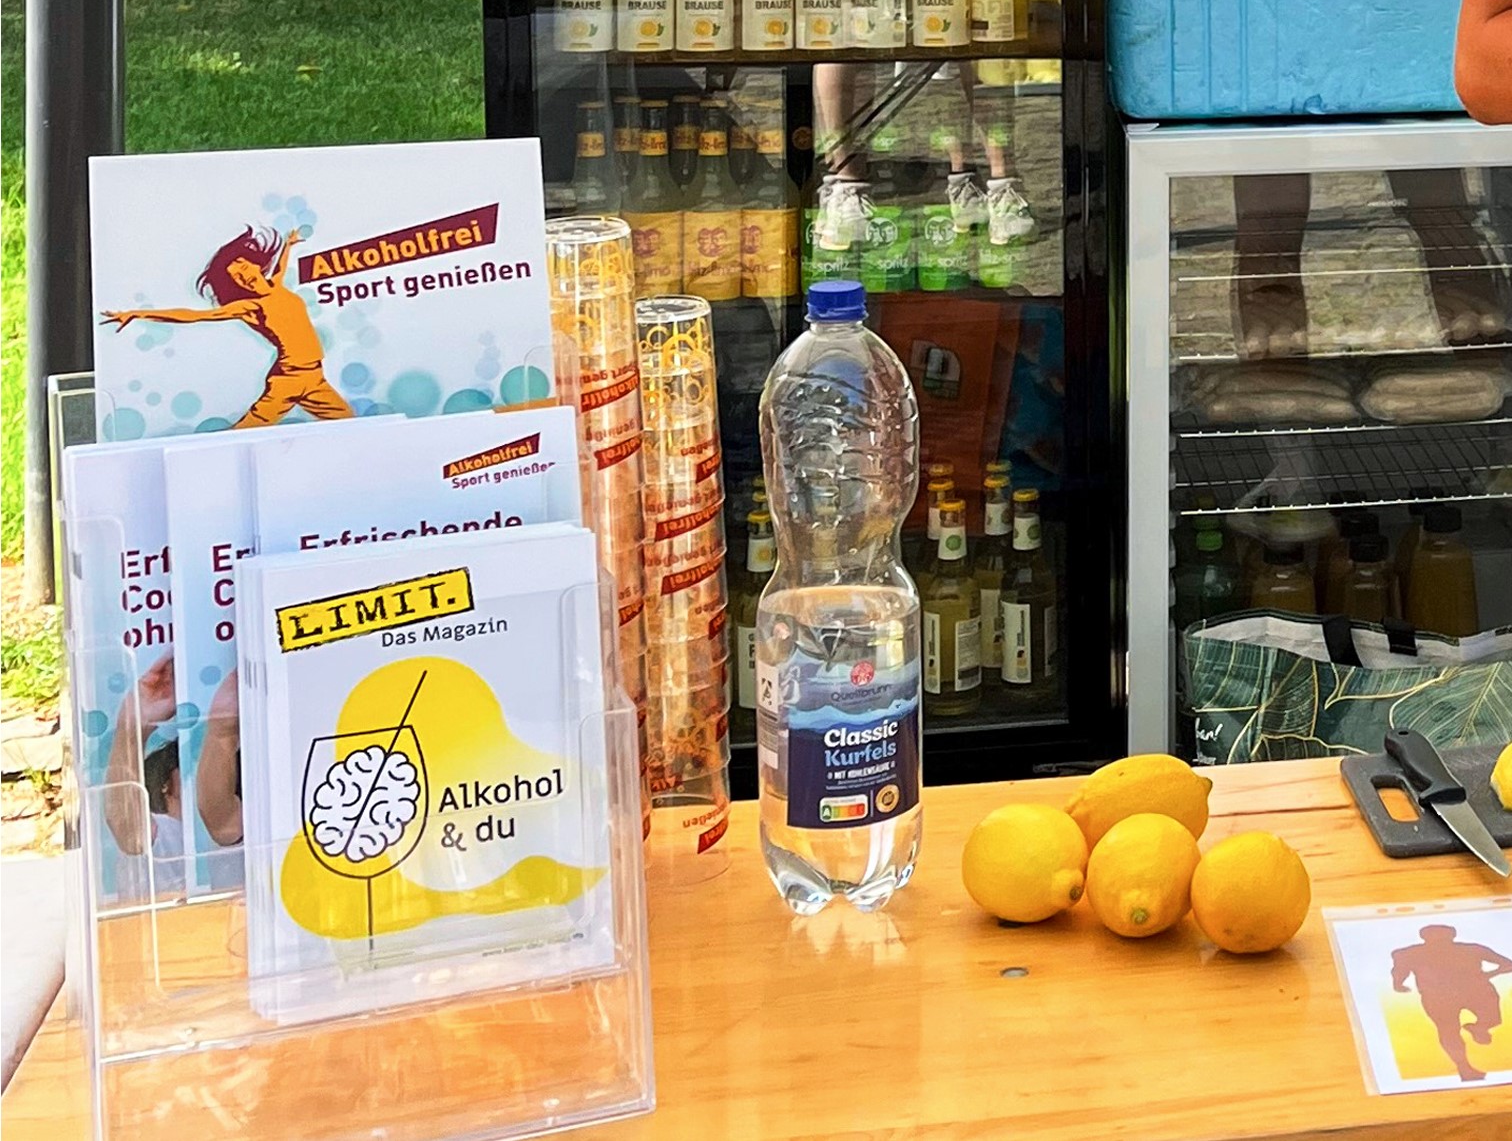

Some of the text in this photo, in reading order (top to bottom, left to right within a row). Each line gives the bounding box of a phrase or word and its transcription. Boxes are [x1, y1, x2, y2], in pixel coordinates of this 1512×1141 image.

[311, 219, 482, 279] Alkoholfrei
[317, 262, 531, 307] Sport genießen
[449, 441, 533, 476] Alkoholfrei
[452, 472, 490, 490] Sport
[289, 580, 457, 641] LIMIT.
[381, 616, 508, 647] Das Magazin
[831, 683, 894, 702] Quellbrunn
[824, 719, 898, 747] Classic
[824, 740, 897, 767] Kurfels
[438, 768, 563, 813] Alkohol
[441, 815, 515, 852] & du
